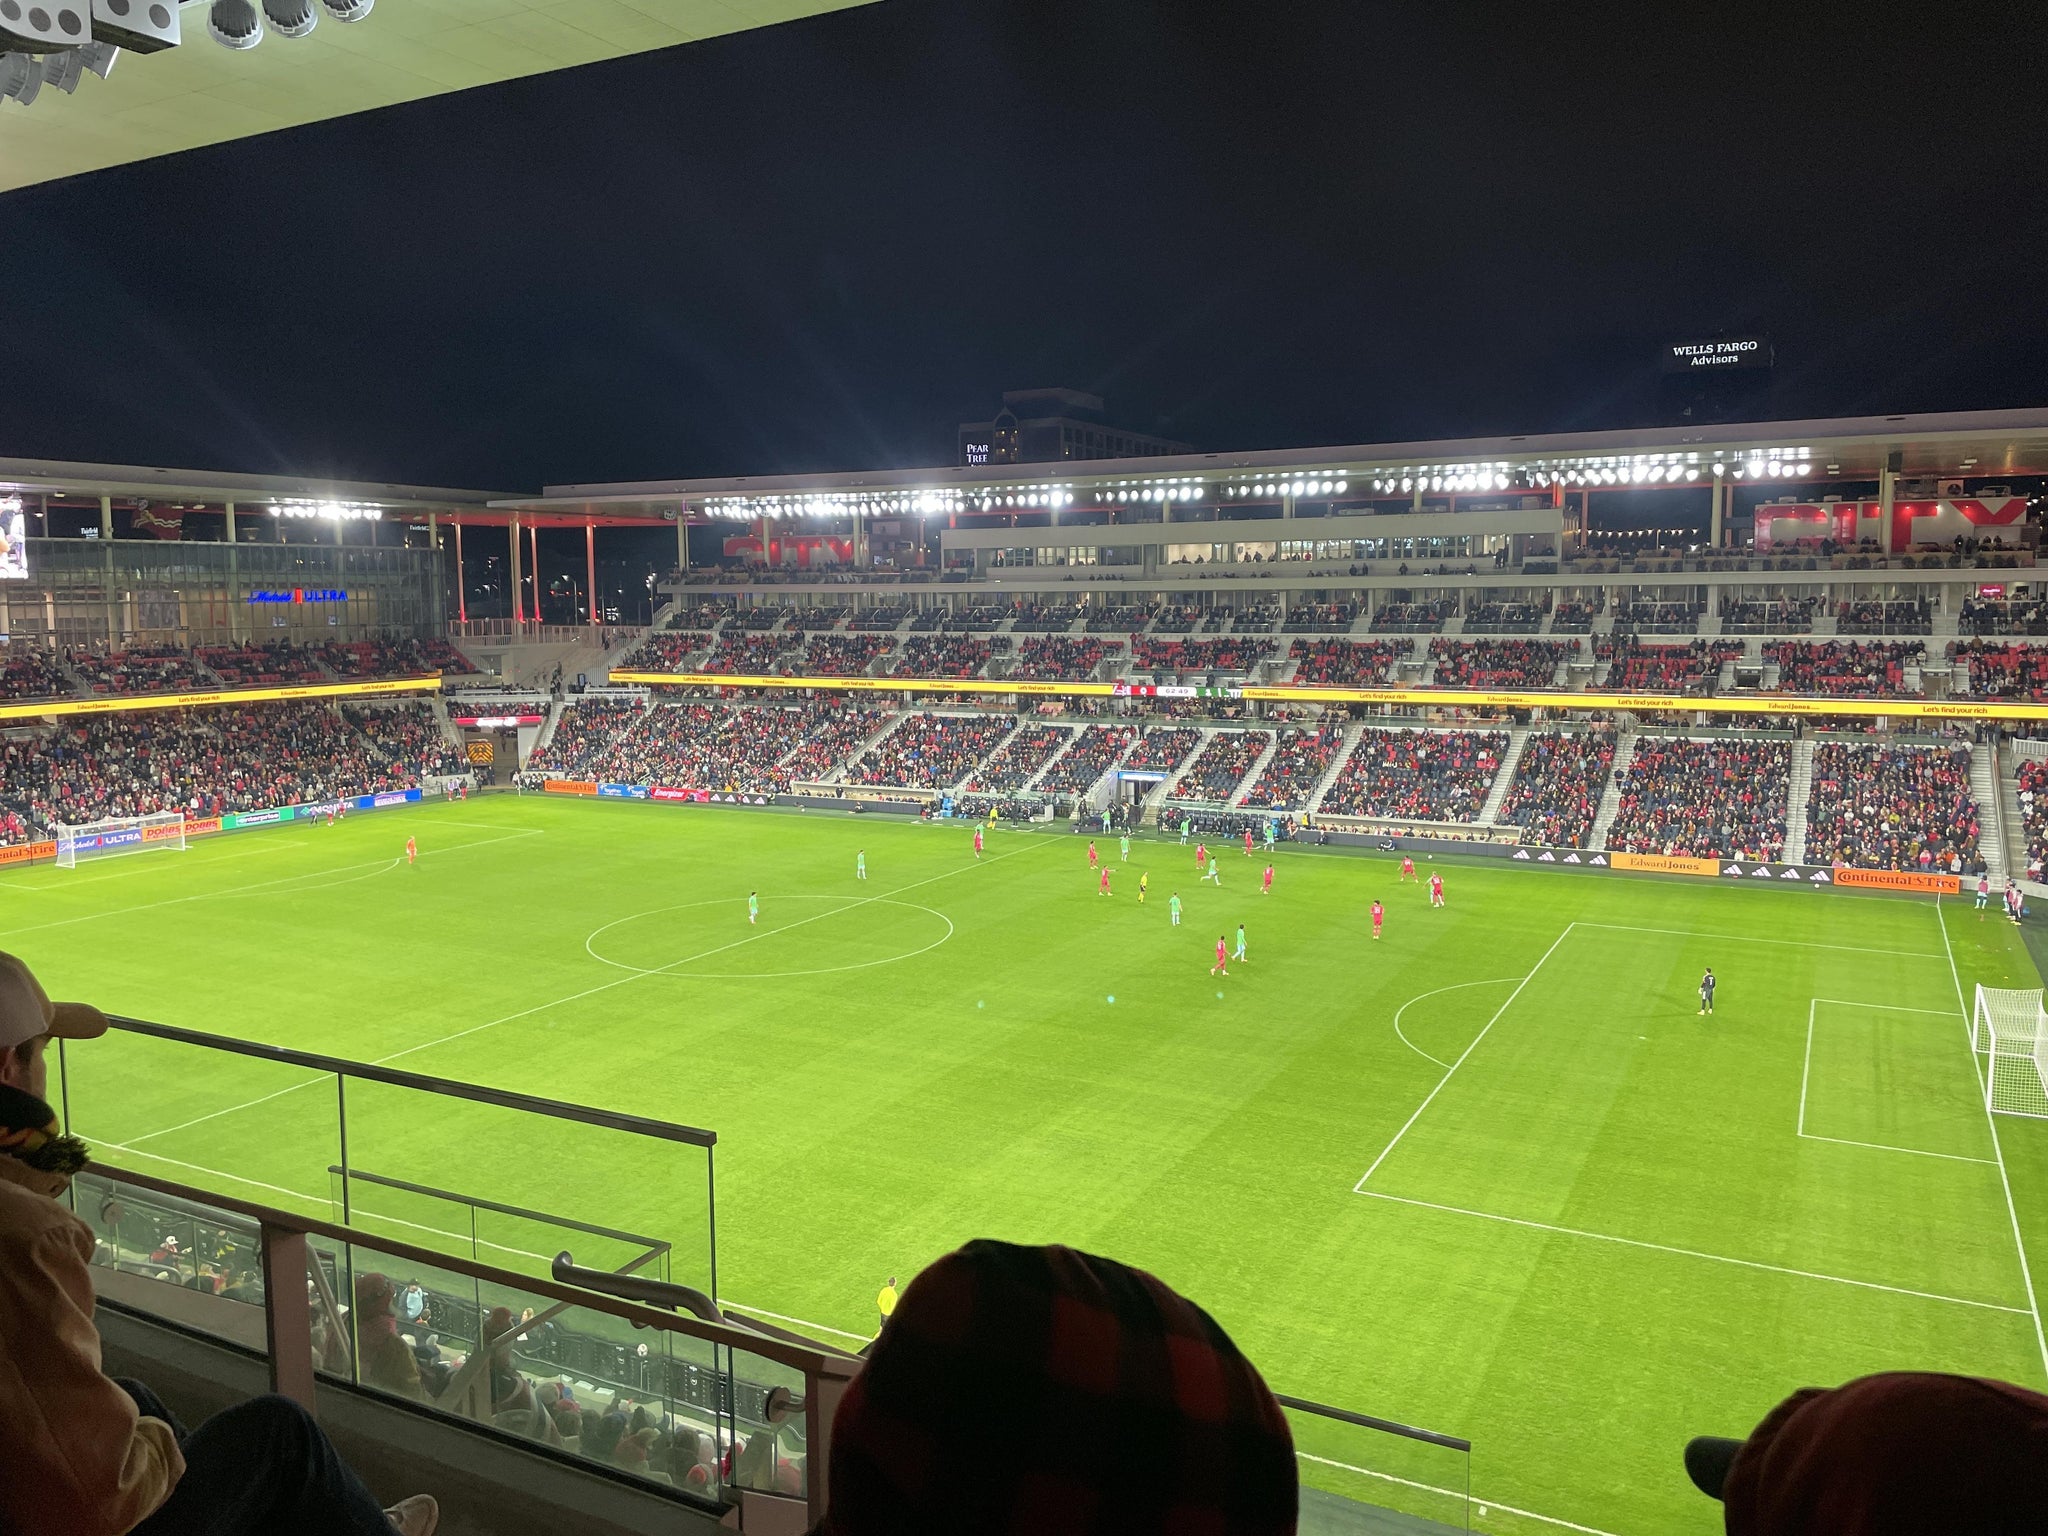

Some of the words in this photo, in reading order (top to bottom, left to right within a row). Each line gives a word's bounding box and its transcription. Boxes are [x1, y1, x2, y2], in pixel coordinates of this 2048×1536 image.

[1673, 345, 1714, 356] WELLS
[1717, 341, 1757, 353] FARGO
[1691, 355, 1738, 366] Advisors
[967, 444, 988, 453] PEAR
[967, 454, 987, 463] TREE
[304, 590, 348, 602] ULTRA
[654, 789, 685, 799] Energizer
[185, 820, 218, 831] DOBBS
[105, 832, 141, 844] ULTRA
[31, 845, 55, 855] Tire
[1837, 872, 1912, 886] Continental
[1923, 877, 1956, 889] Tire
